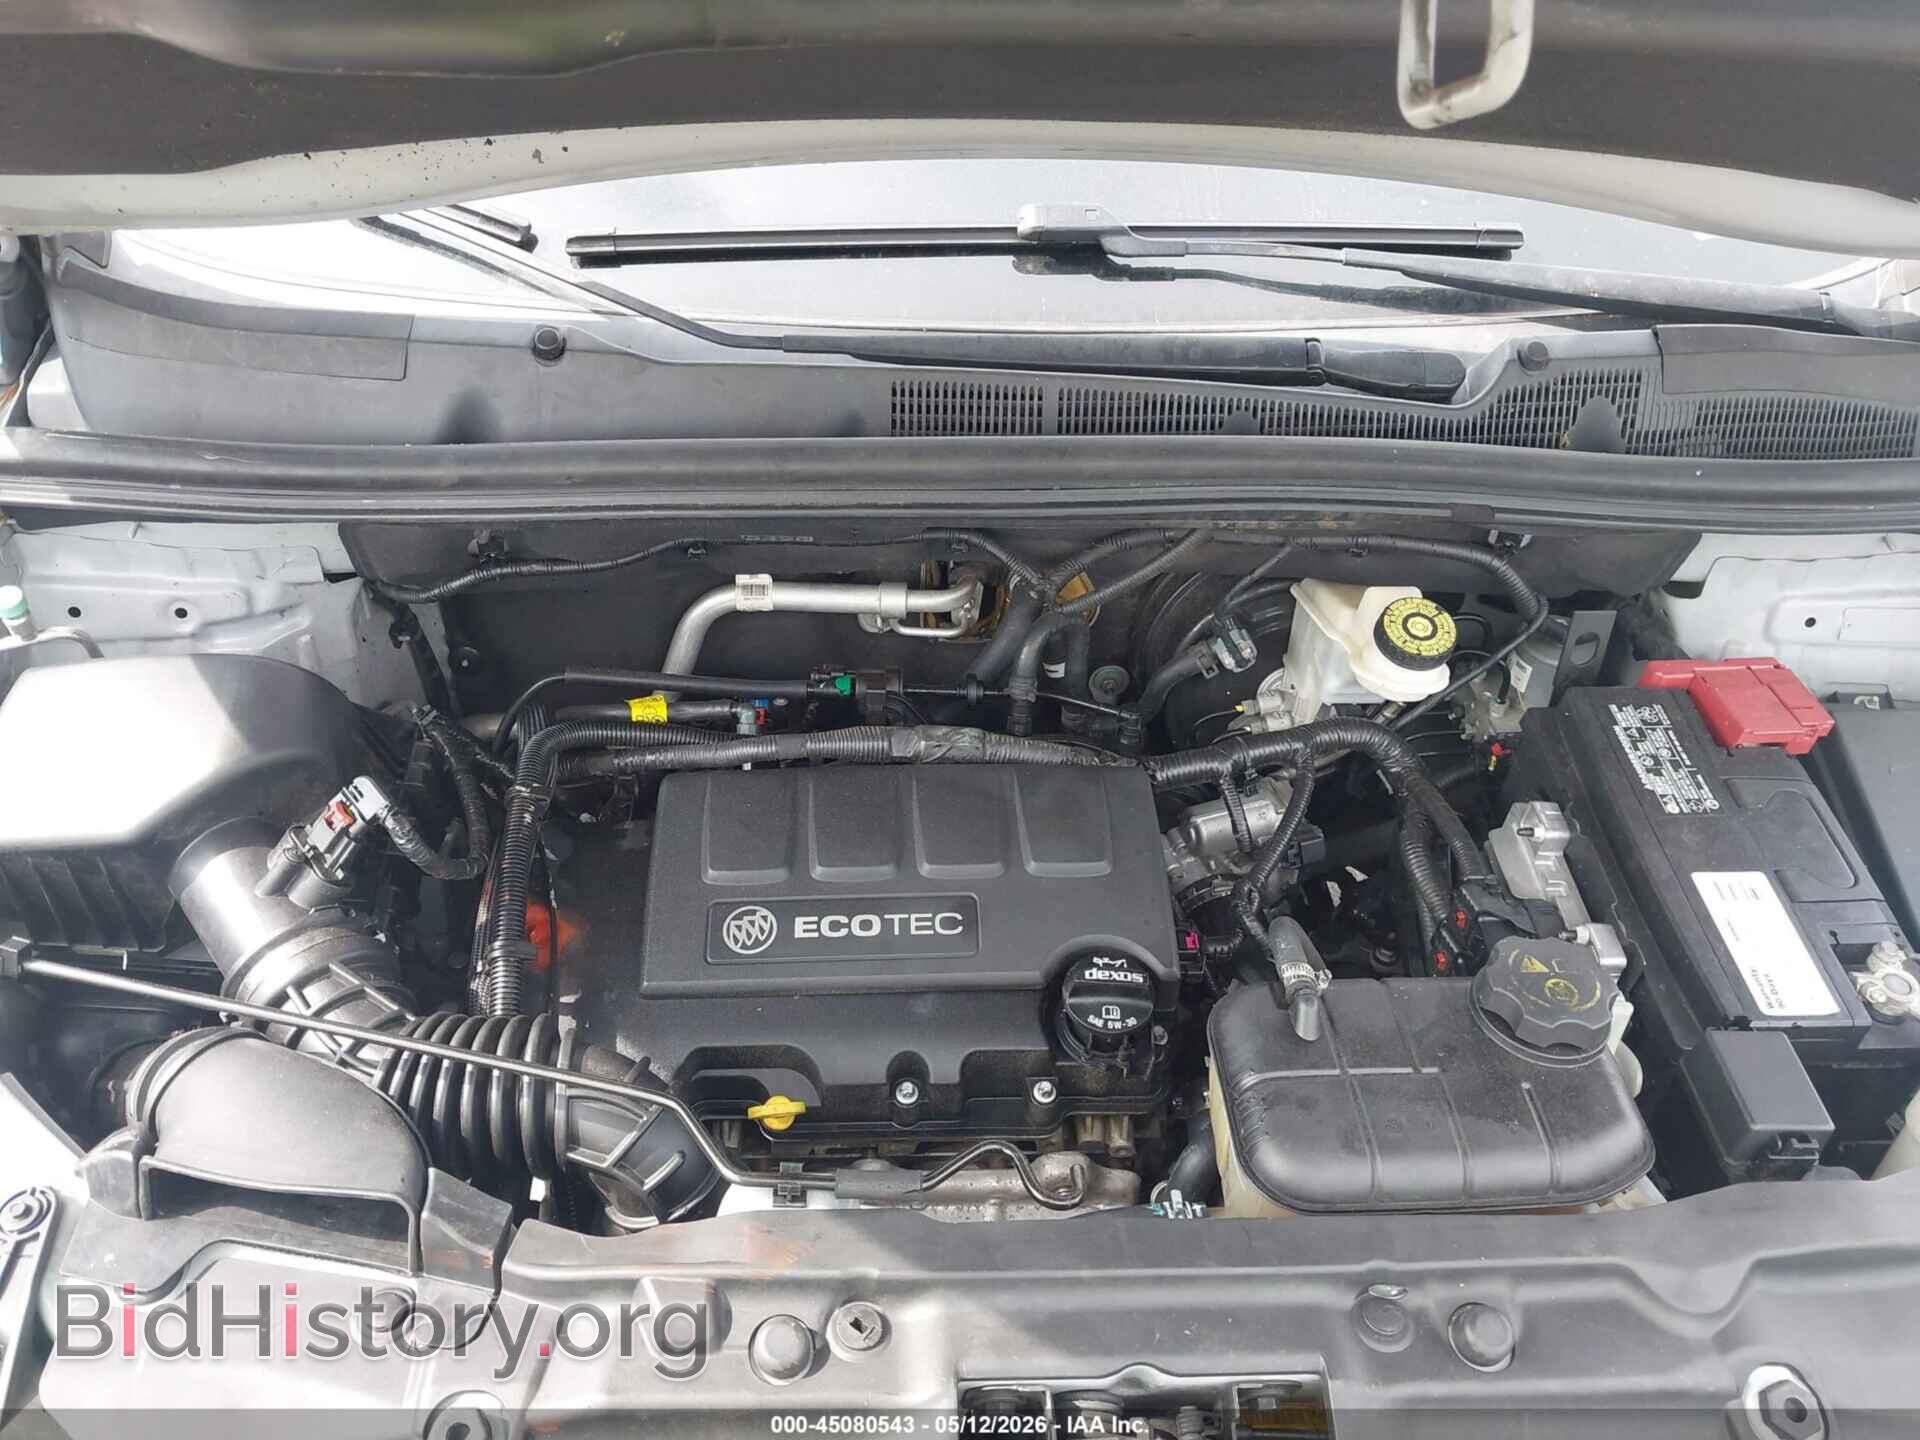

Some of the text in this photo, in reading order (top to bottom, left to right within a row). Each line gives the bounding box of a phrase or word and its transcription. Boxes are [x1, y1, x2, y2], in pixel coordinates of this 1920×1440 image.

[794, 912, 964, 938] ECOTEC
[1084, 967, 1144, 983] dexos
[1087, 1014, 1105, 1028] SAE
